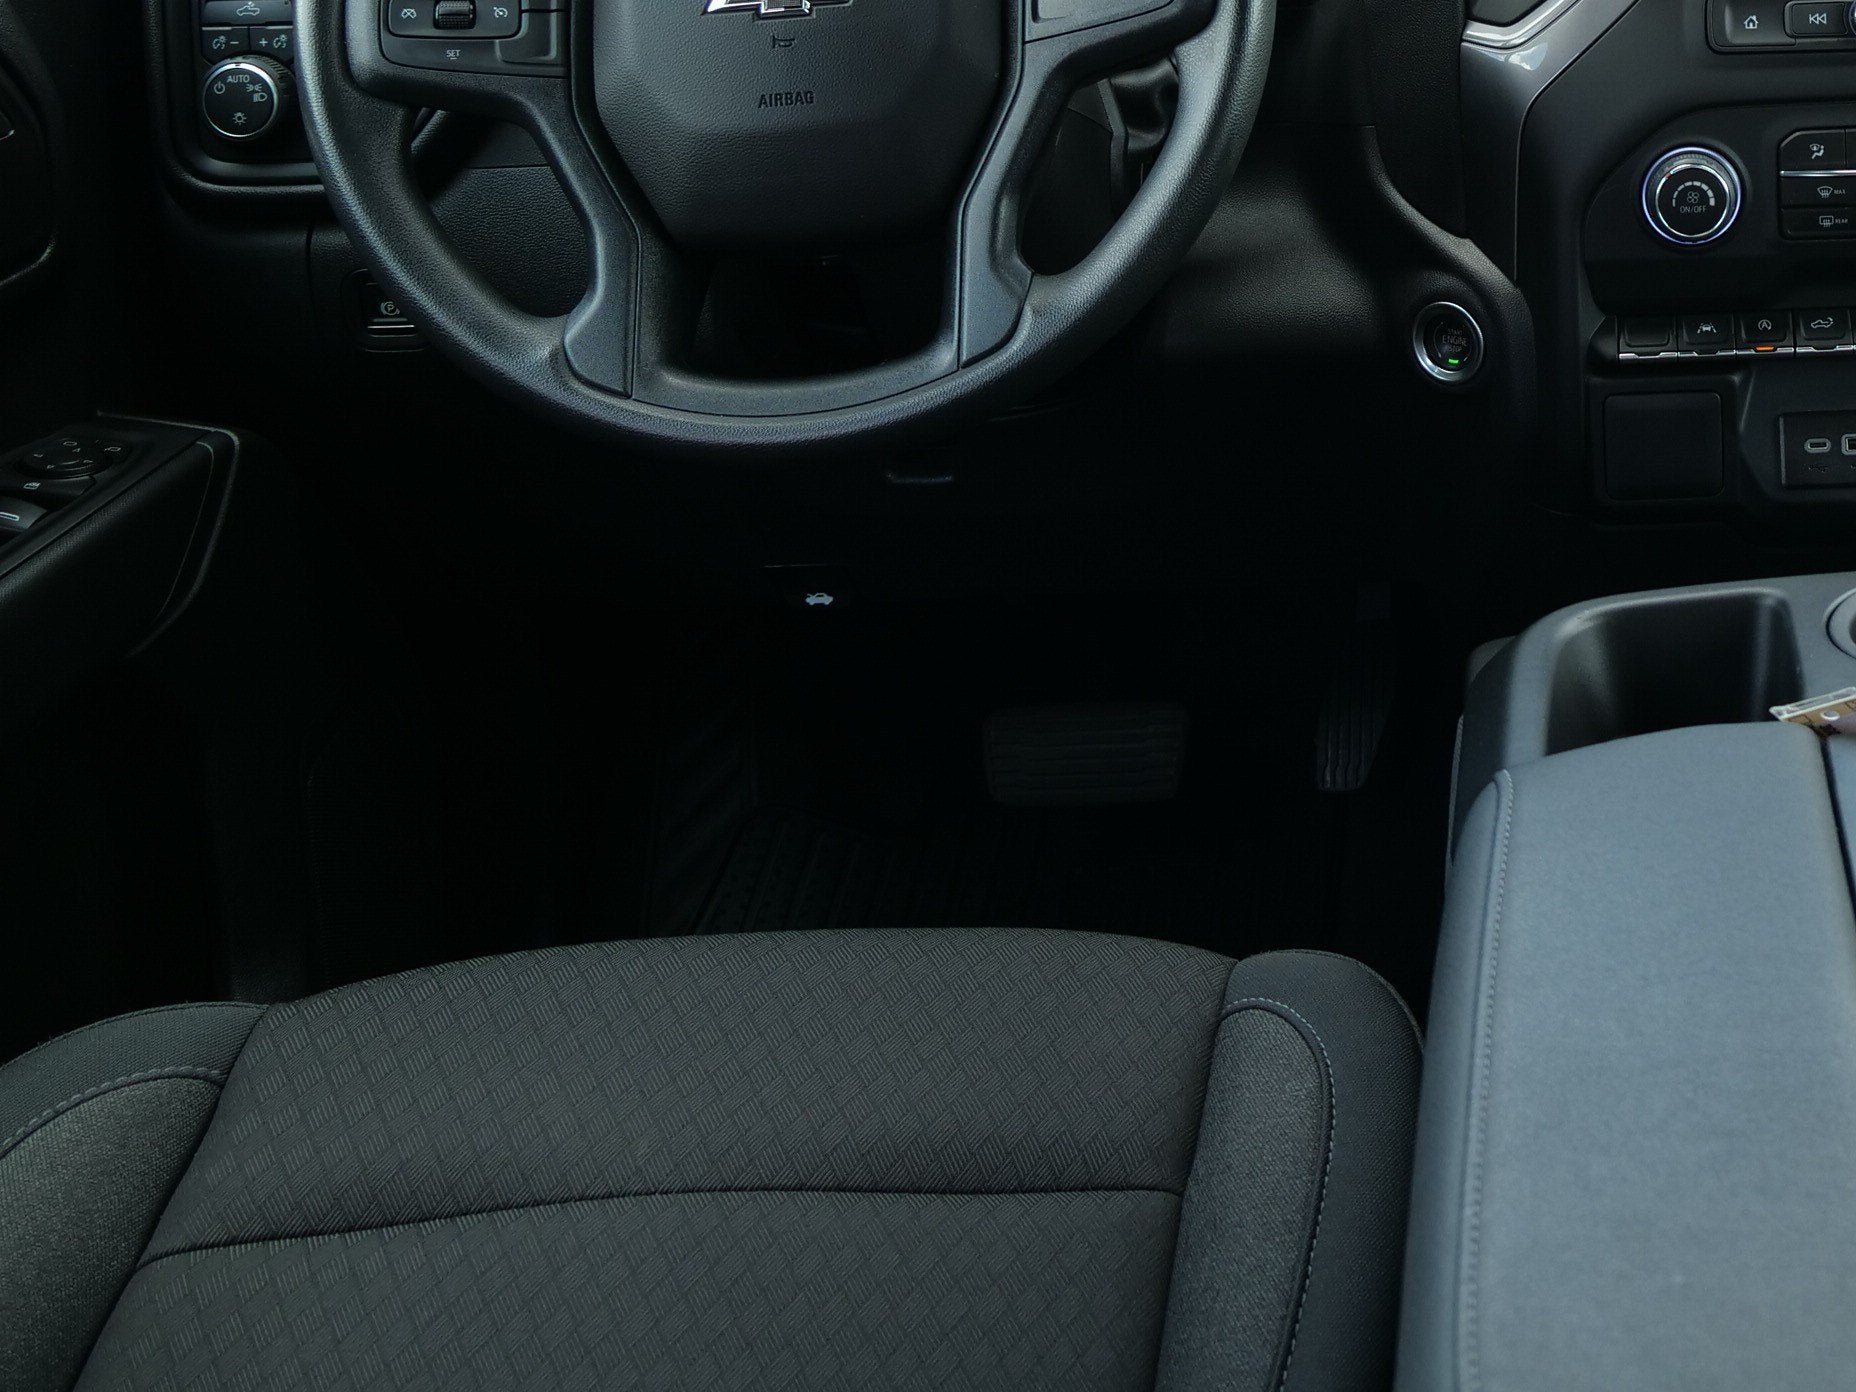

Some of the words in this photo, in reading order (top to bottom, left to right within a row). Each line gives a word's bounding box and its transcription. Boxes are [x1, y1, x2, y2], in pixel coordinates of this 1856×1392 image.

[227, 74, 250, 83] AUTO
[758, 91, 814, 108] AIRBAG
[1680, 206, 1706, 214] ON/OFF
[1442, 336, 1468, 346] ENGINE
